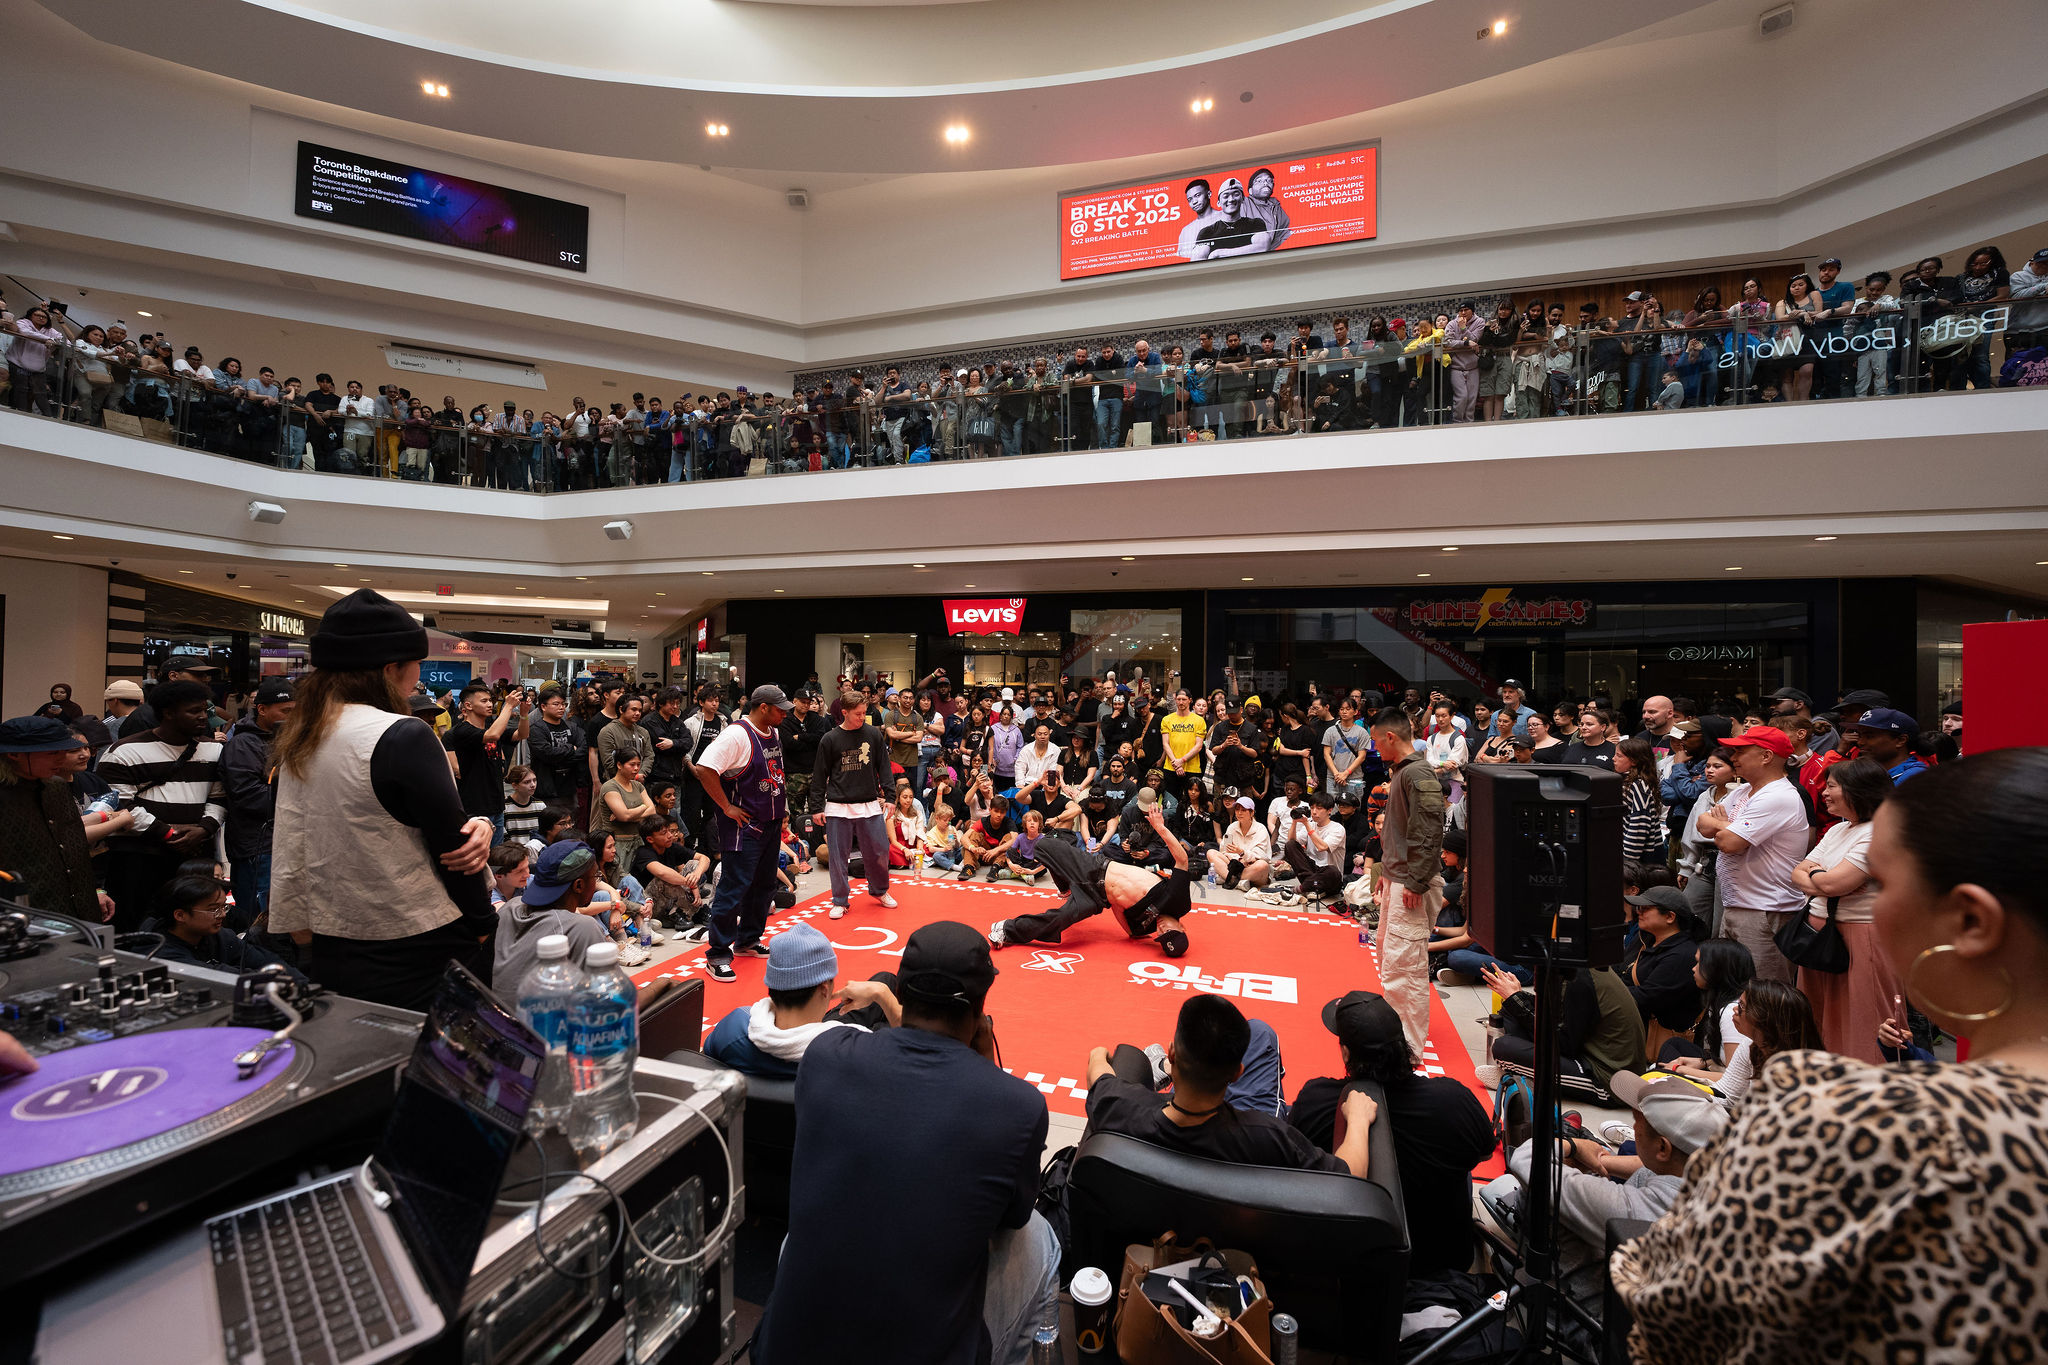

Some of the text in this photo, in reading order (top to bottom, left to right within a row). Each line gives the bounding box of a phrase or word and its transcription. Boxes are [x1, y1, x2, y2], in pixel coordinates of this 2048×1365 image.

[1350, 156, 1364, 164] STC
[314, 156, 408, 184] Toronto Breakdance
[314, 164, 372, 184] Competition
[312, 175, 341, 186] Experience
[312, 182, 330, 190] B-boys
[312, 190, 323, 198] May
[334, 194, 350, 202] Centre
[1284, 181, 1364, 198] CANADIAN OLYMPIC
[1323, 188, 1364, 200] MEDALIST
[1071, 193, 1169, 221] BREAK TO
[1330, 196, 1364, 205] WIZARD
[1070, 206, 1181, 237] @ STC 2025
[1085, 232, 1120, 244] BREAKING
[1122, 228, 1148, 237] BATTLE
[1290, 226, 1327, 234] SCARBOROUGH
[560, 251, 580, 264] STC
[974, 421, 989, 434] GAP
[439, 586, 452, 594] EXIT
[1410, 601, 1586, 620] MIND GAMES
[430, 672, 453, 682] STC
[572, 1026, 628, 1047] AQUAFINA
